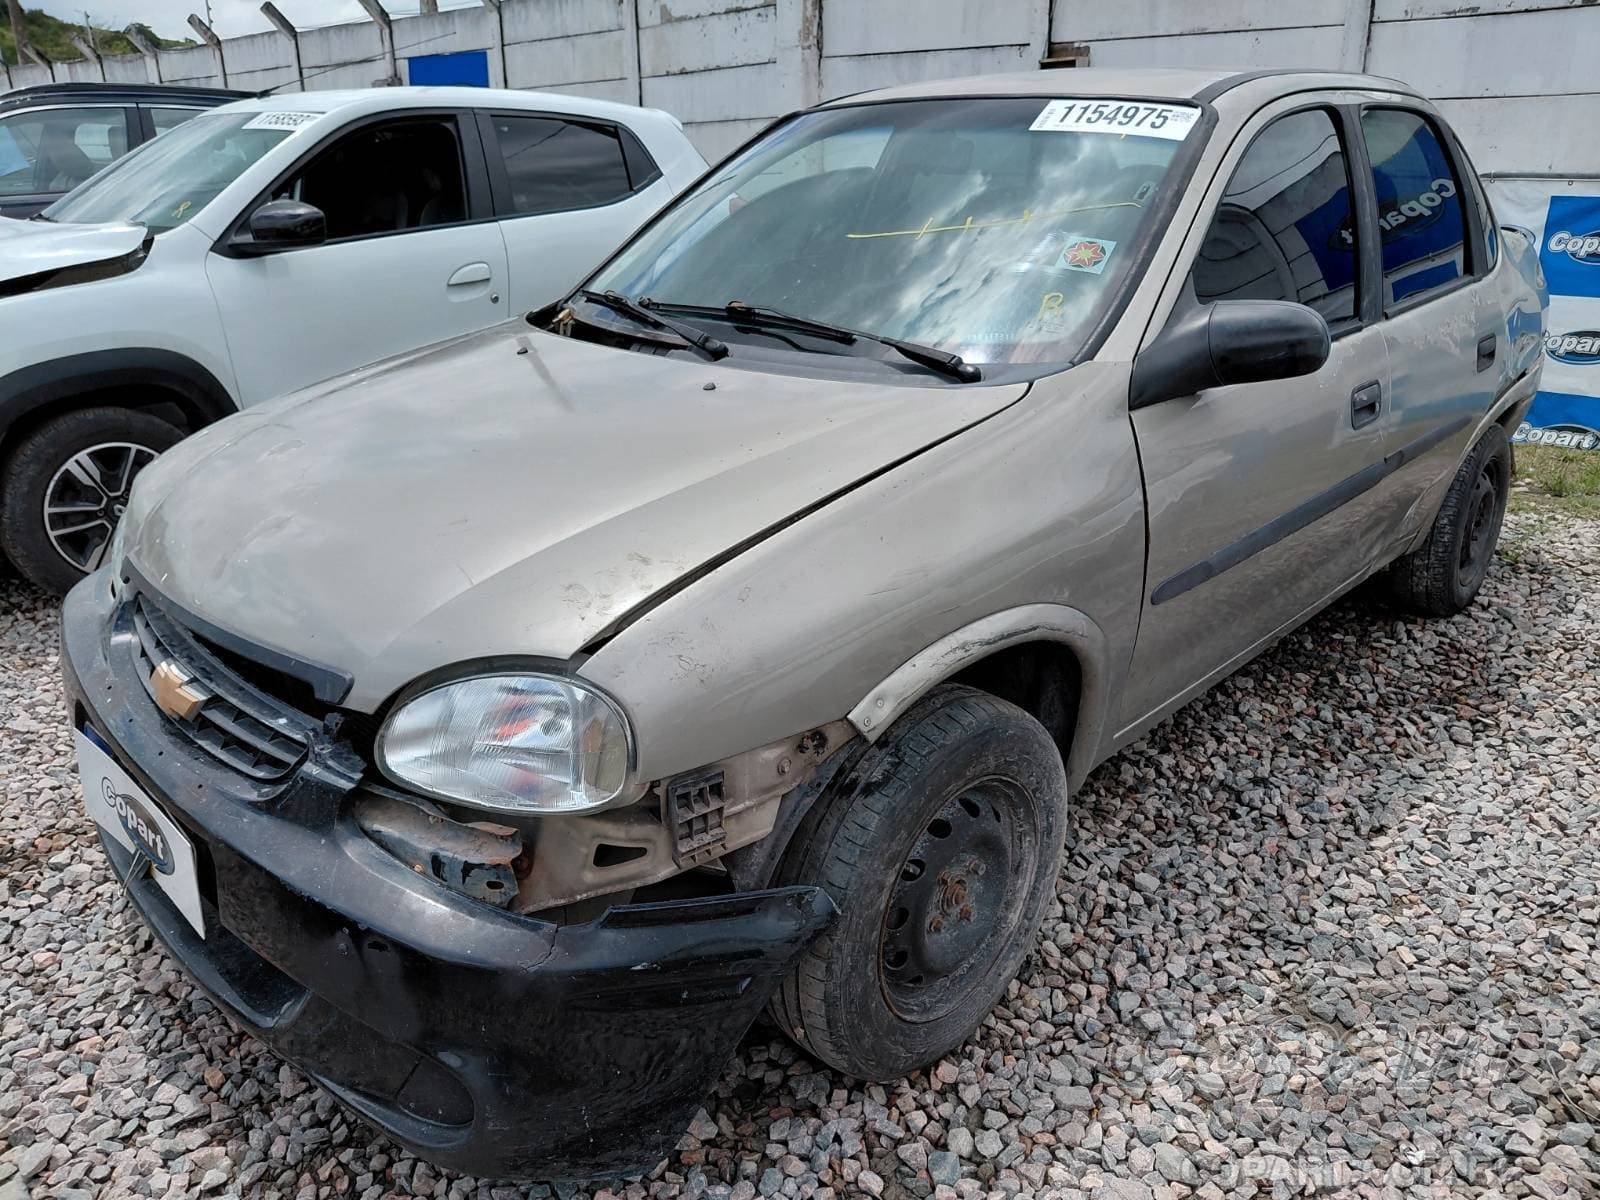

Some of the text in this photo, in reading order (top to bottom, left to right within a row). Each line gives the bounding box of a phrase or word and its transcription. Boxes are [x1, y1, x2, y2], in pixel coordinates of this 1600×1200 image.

[1059, 103, 1173, 129] 1154975
[1548, 231, 1600, 258] Cop
[1543, 330, 1600, 355] opar
[1511, 422, 1598, 450] Copart
[101, 776, 165, 861] Copart
